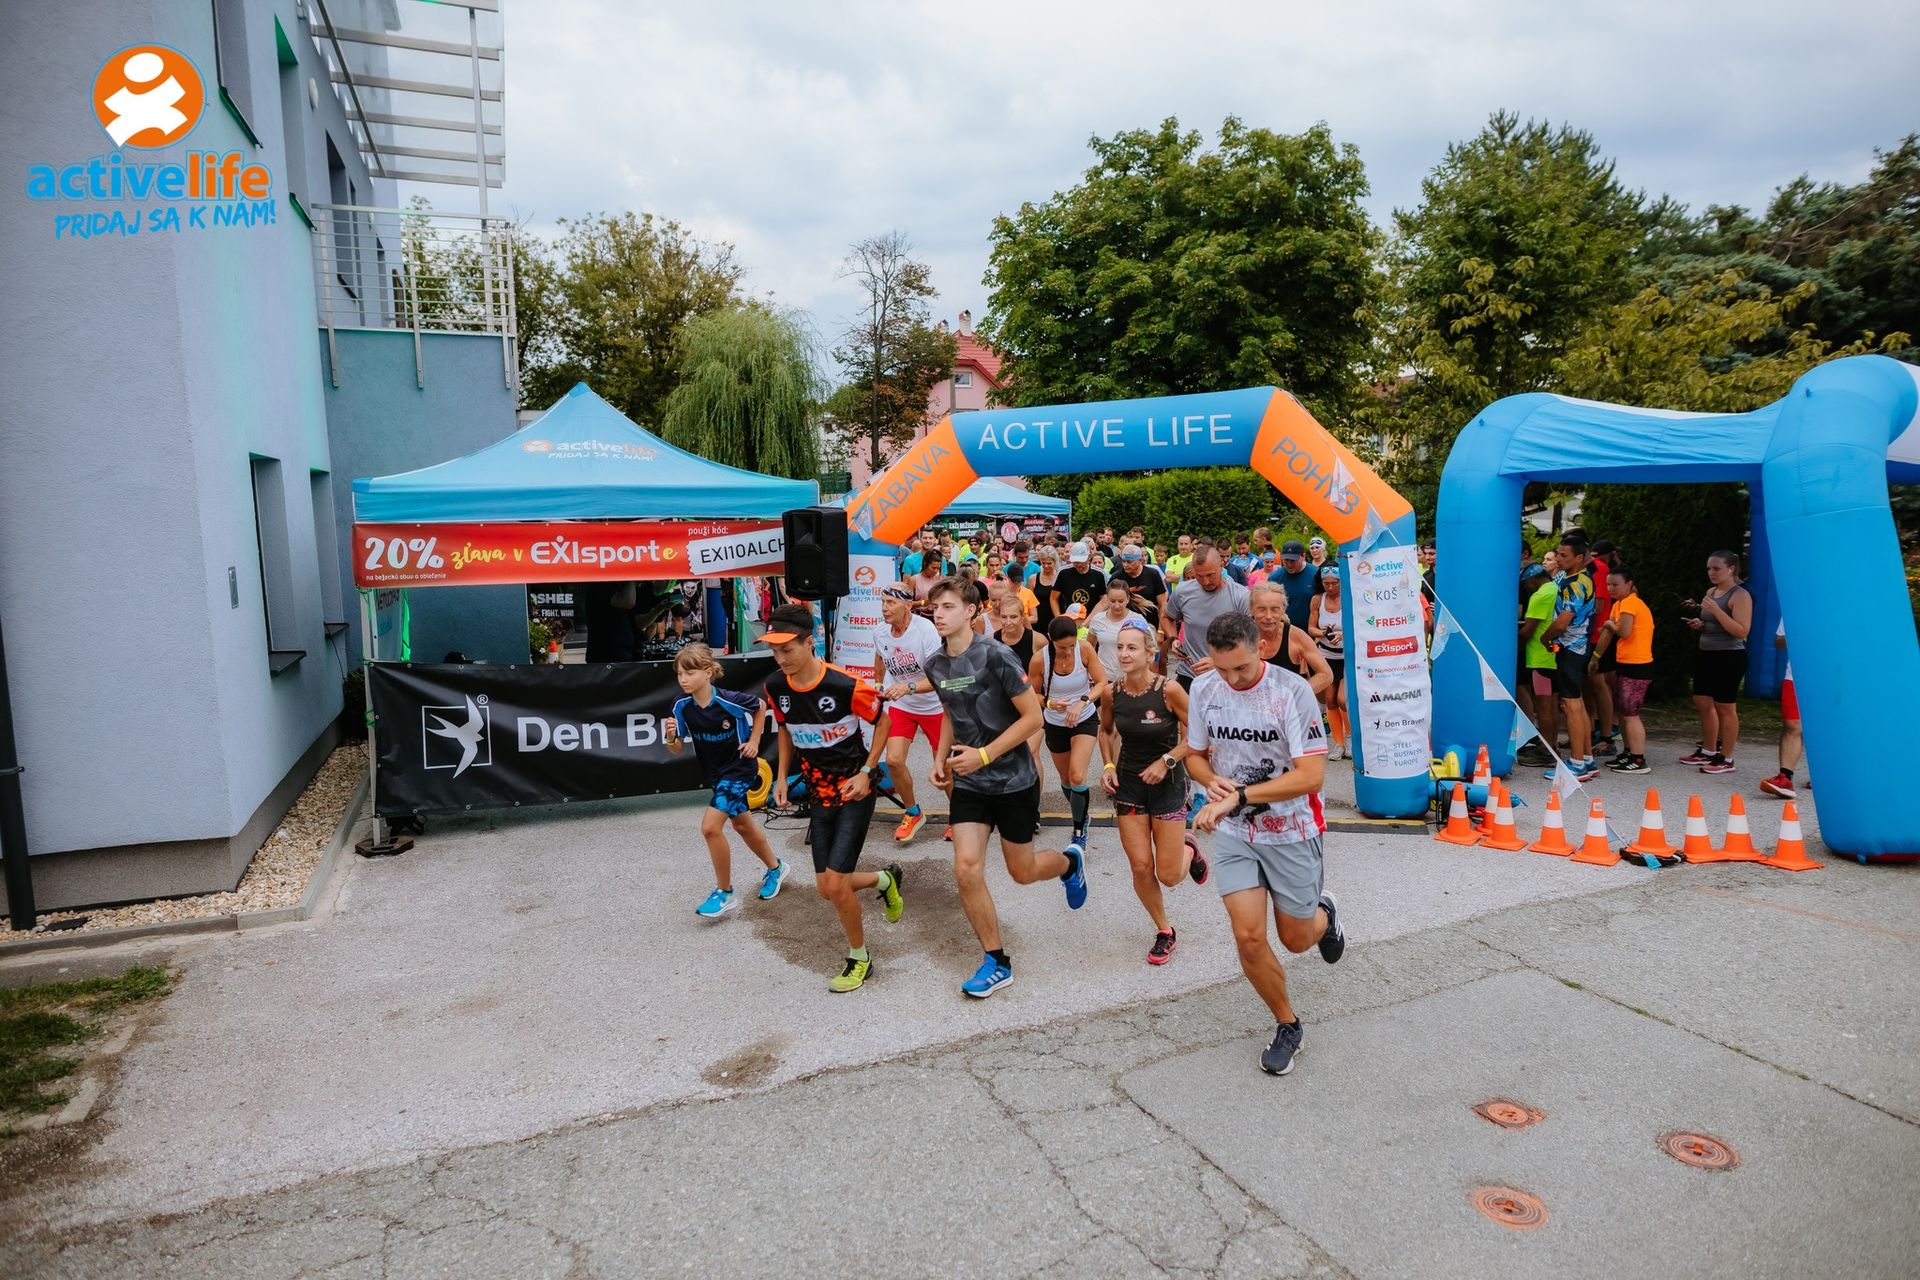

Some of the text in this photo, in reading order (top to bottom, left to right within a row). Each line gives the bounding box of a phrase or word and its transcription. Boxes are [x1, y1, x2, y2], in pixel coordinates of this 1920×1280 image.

[978, 413, 1233, 450] ACTIVE LIFE
[556, 440, 657, 456] activelife
[364, 536, 444, 570] 20%
[450, 542, 507, 570] zľava
[513, 548, 524, 562] v
[849, 616, 878, 625] FRESH
[1376, 616, 1407, 628] FRESH
[1383, 690, 1422, 702] MAGNA
[517, 716, 609, 752] Den
[1217, 726, 1280, 742] MAGNA
